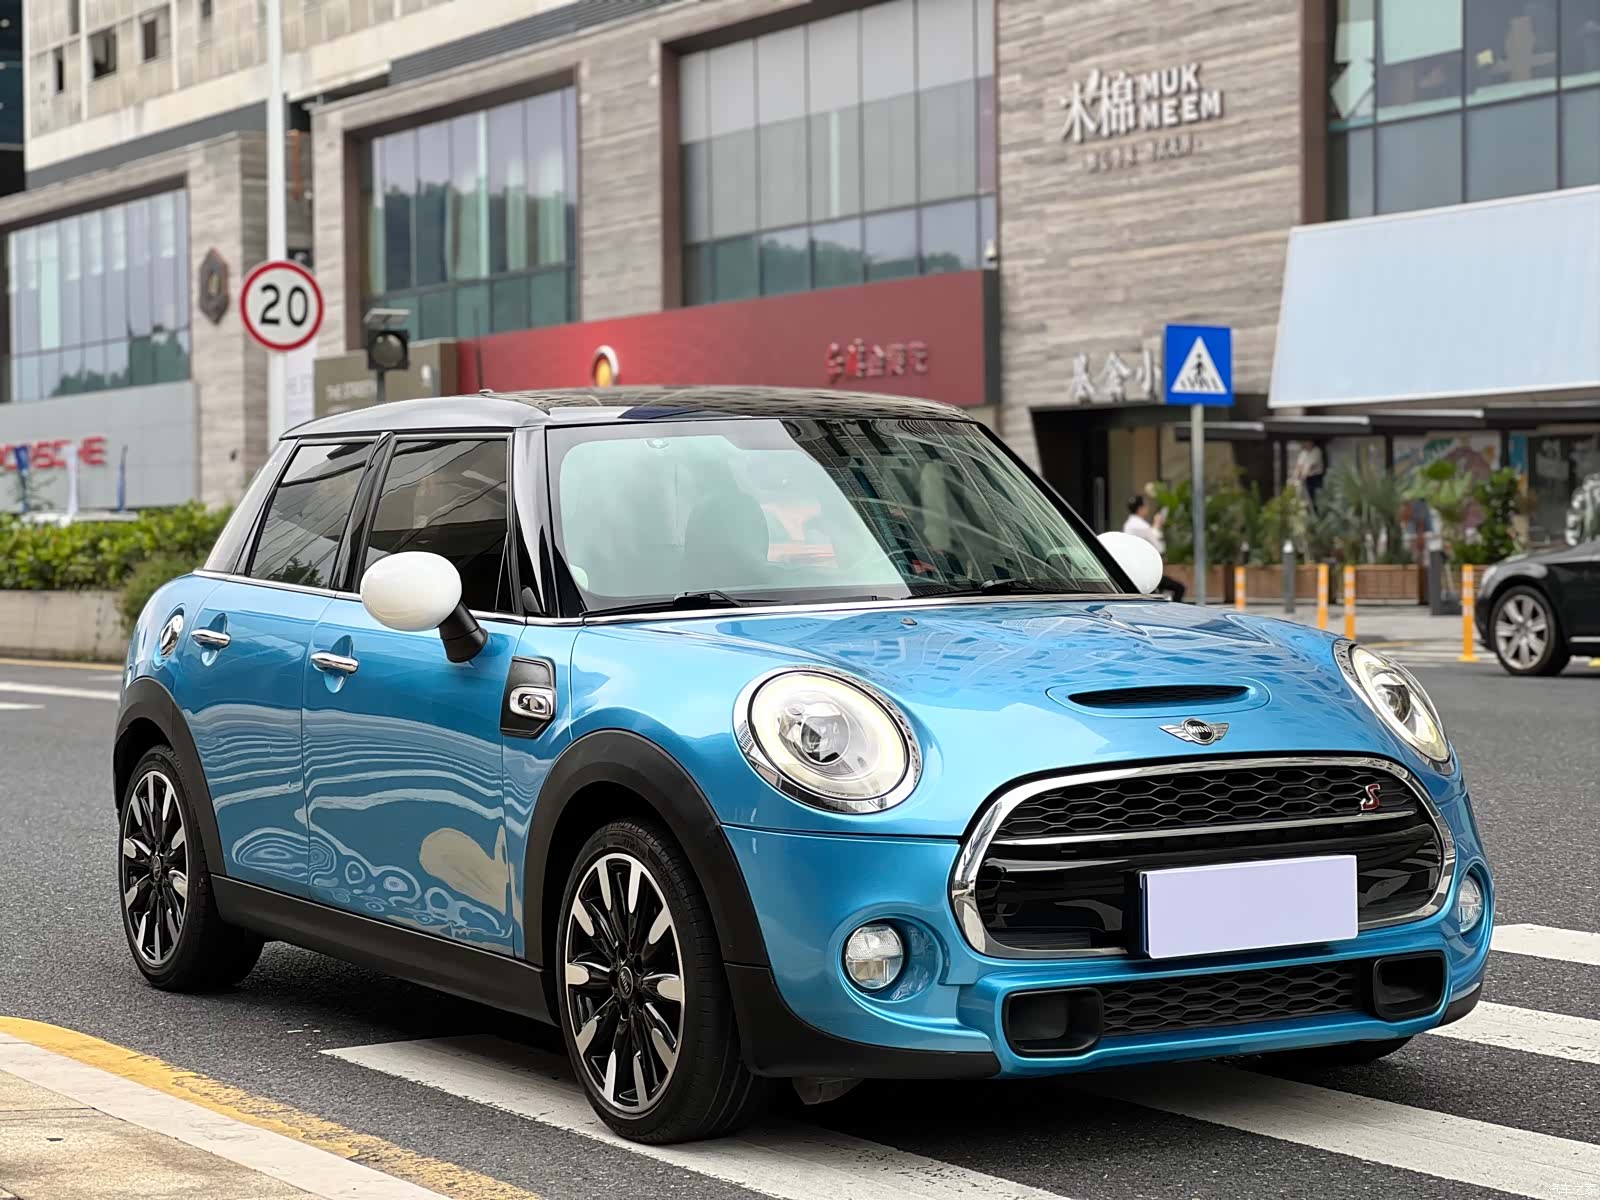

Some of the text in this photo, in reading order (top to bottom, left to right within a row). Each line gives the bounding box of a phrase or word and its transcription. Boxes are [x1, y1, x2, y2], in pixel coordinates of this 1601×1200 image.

[1139, 62, 1200, 100] MUK
[1060, 68, 1135, 143] 木棉
[1139, 90, 1223, 130] MEEM
[260, 284, 308, 326] 20
[1187, 725, 1212, 734] MINI
[1360, 783, 1381, 811] S
